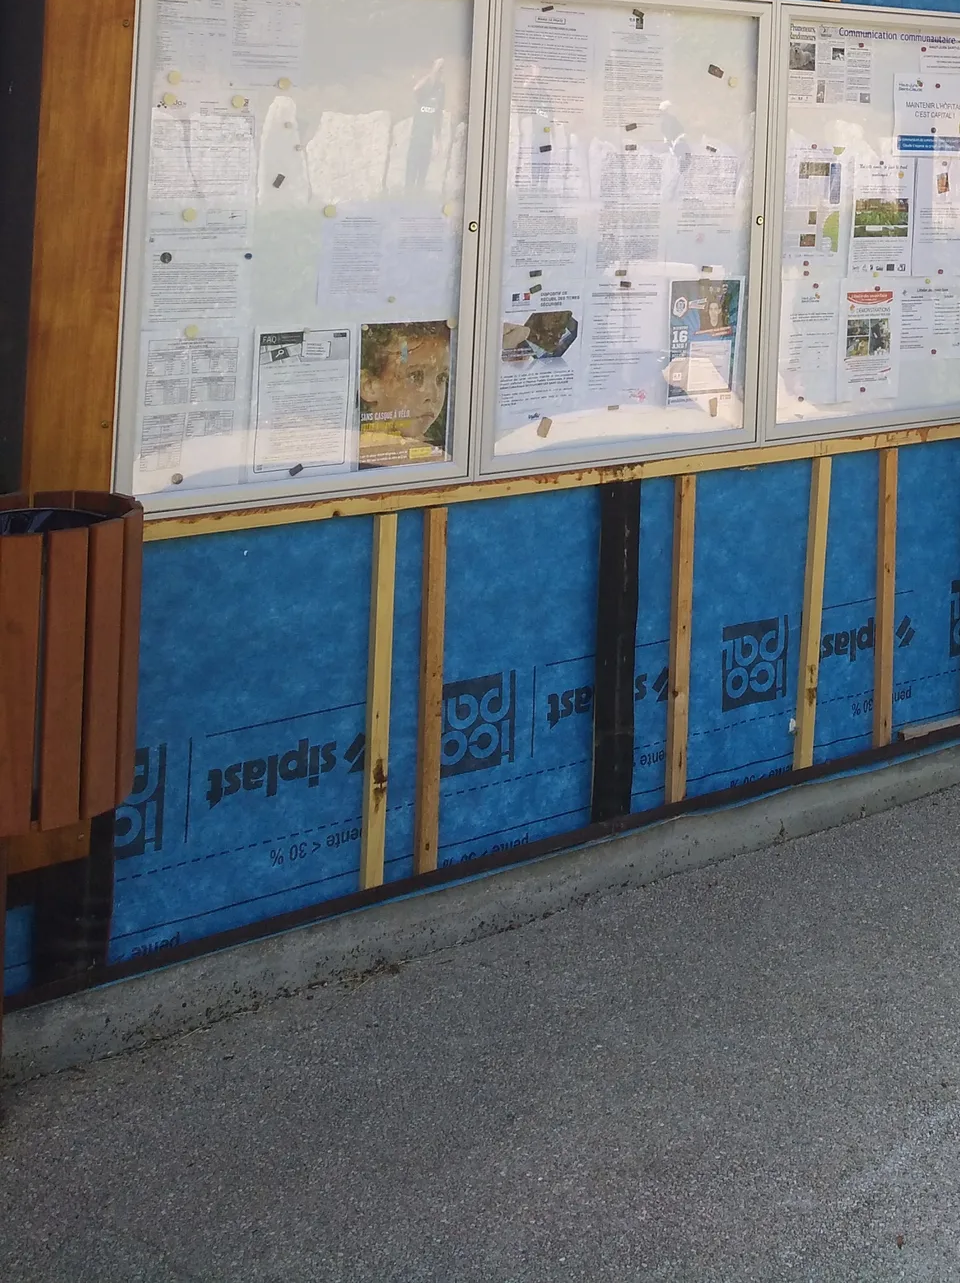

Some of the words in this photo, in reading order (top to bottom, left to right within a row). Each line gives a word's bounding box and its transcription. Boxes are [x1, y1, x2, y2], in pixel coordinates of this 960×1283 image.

[838, 26, 897, 40] Communication
[900, 32, 957, 45] communautaire
[262, 336, 277, 344] FAQ
[672, 330, 689, 343] 16
[640, 750, 665, 767] ente
[206, 737, 337, 810] siplast
[270, 849, 284, 867] %
[289, 843, 308, 862] 30
